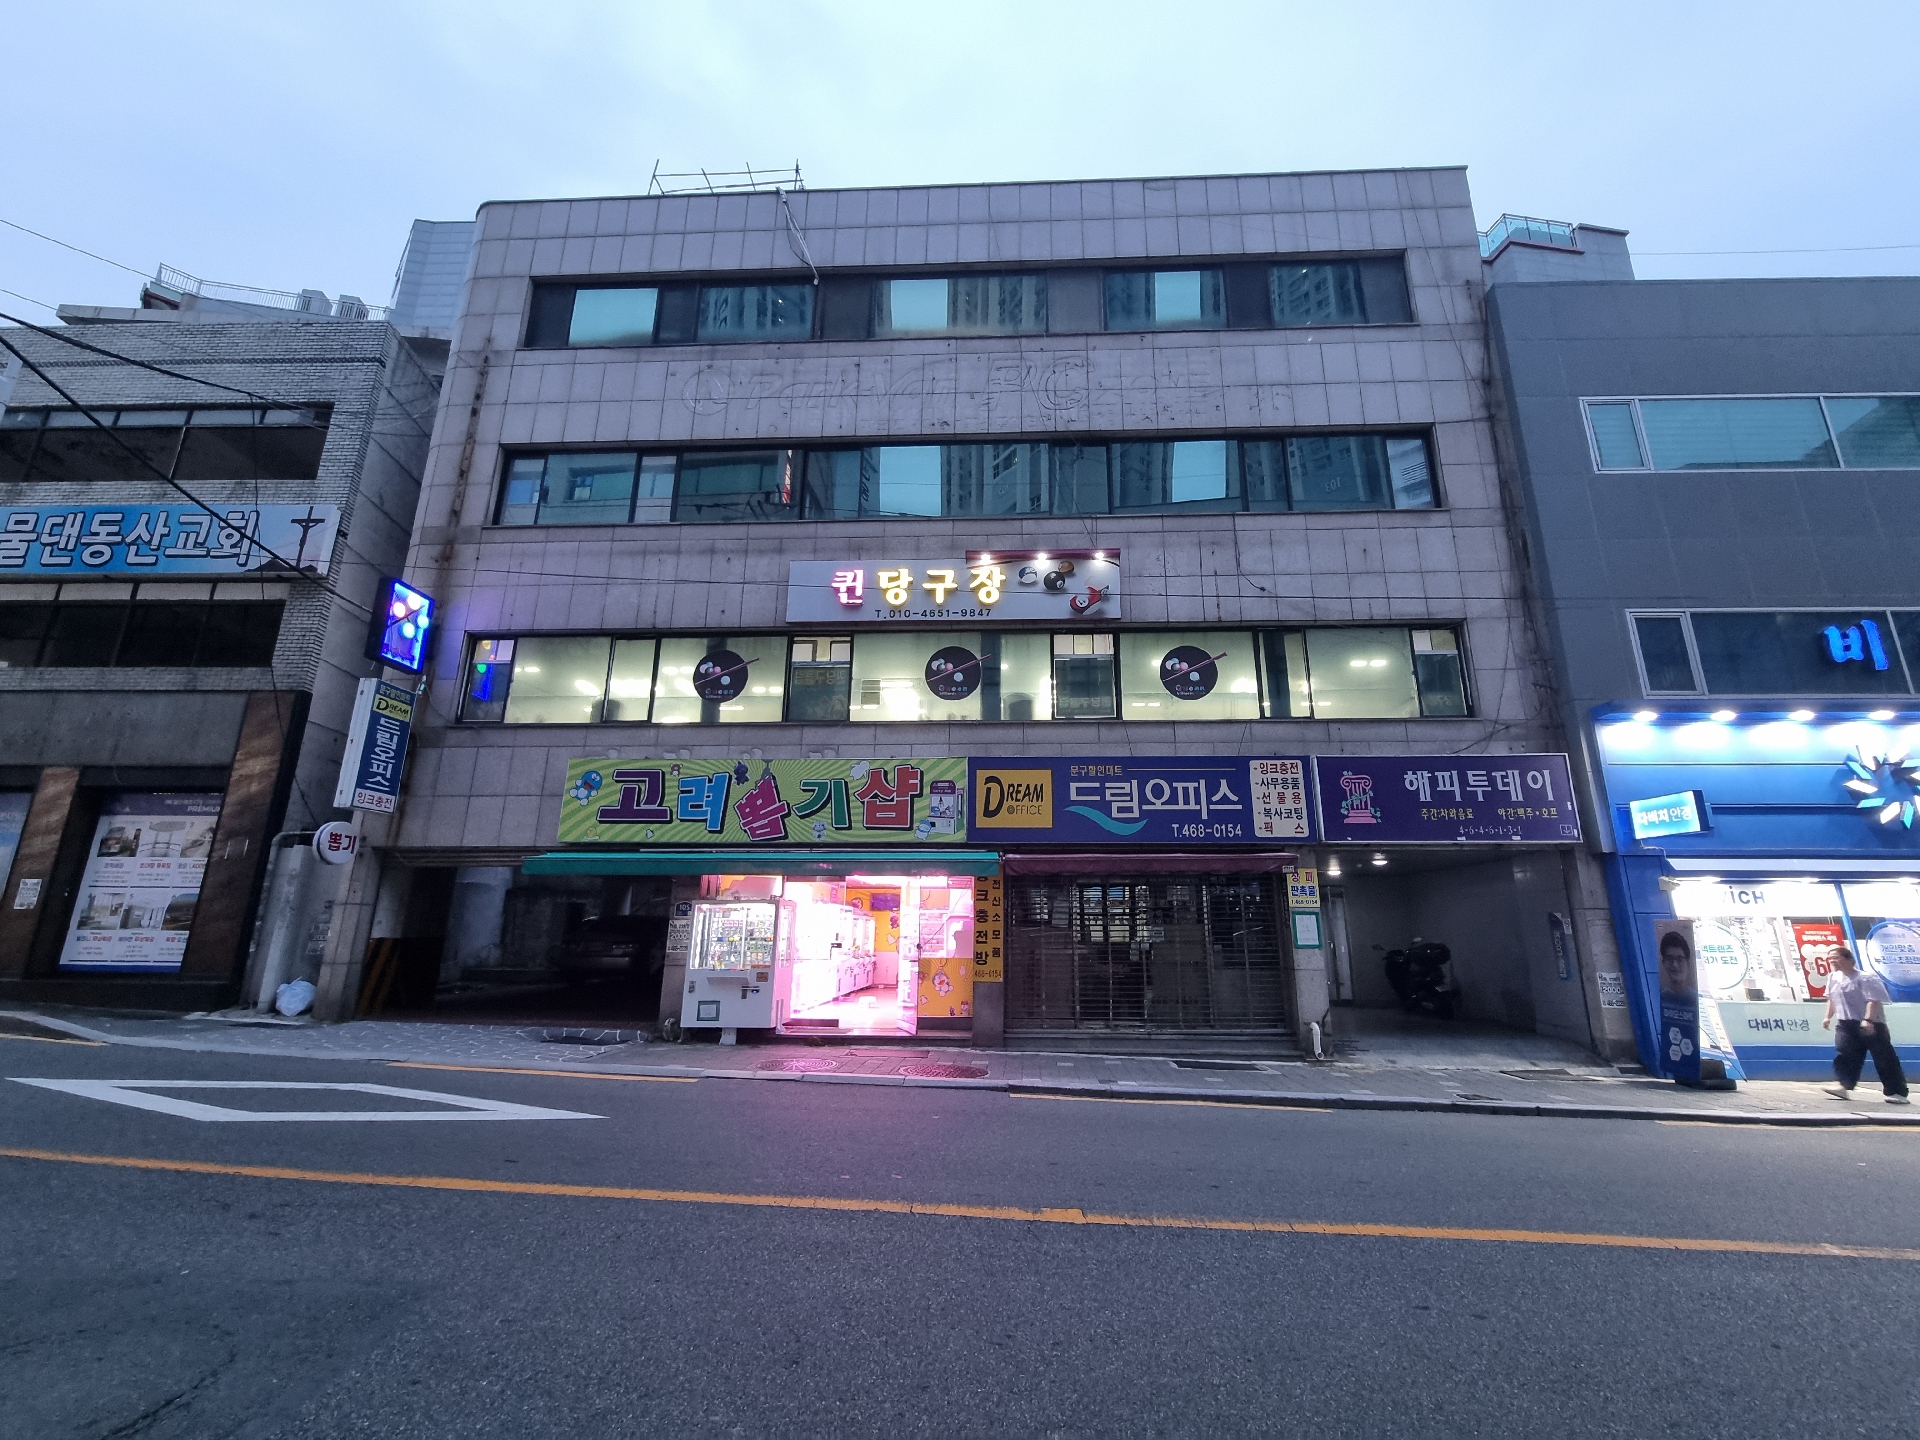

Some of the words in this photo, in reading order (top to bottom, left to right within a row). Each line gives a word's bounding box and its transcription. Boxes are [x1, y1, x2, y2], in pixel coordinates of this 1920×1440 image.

[0, 510, 259, 567] 물댄동산교회
[831, 568, 864, 606] 퀸
[877, 567, 1007, 606] 당구장
[875, 608, 992, 620] T.010-4651-9847
[1823, 618, 1888, 671] 비
[376, 697, 410, 716] DREAM
[365, 717, 400, 791] 드림오피스
[1070, 765, 1123, 777] 문구할인마트
[1259, 762, 1299, 775] 잉크충전
[1260, 777, 1300, 790] 사무용품
[1403, 769, 1555, 802] 해피투데이
[357, 791, 393, 810] 잉크충전
[983, 776, 1044, 818] DREAM
[1069, 778, 1243, 820] 드림오피스
[1006, 804, 1043, 815] OFFICE
[1263, 807, 1304, 820] 복사코팅
[1171, 823, 1242, 838] T.468-0154
[328, 831, 357, 854] 뽑기
[1290, 885, 1316, 897] 판촉물
[1748, 1018, 1785, 1032] 다비치
[1786, 1018, 1811, 1032] 안경
